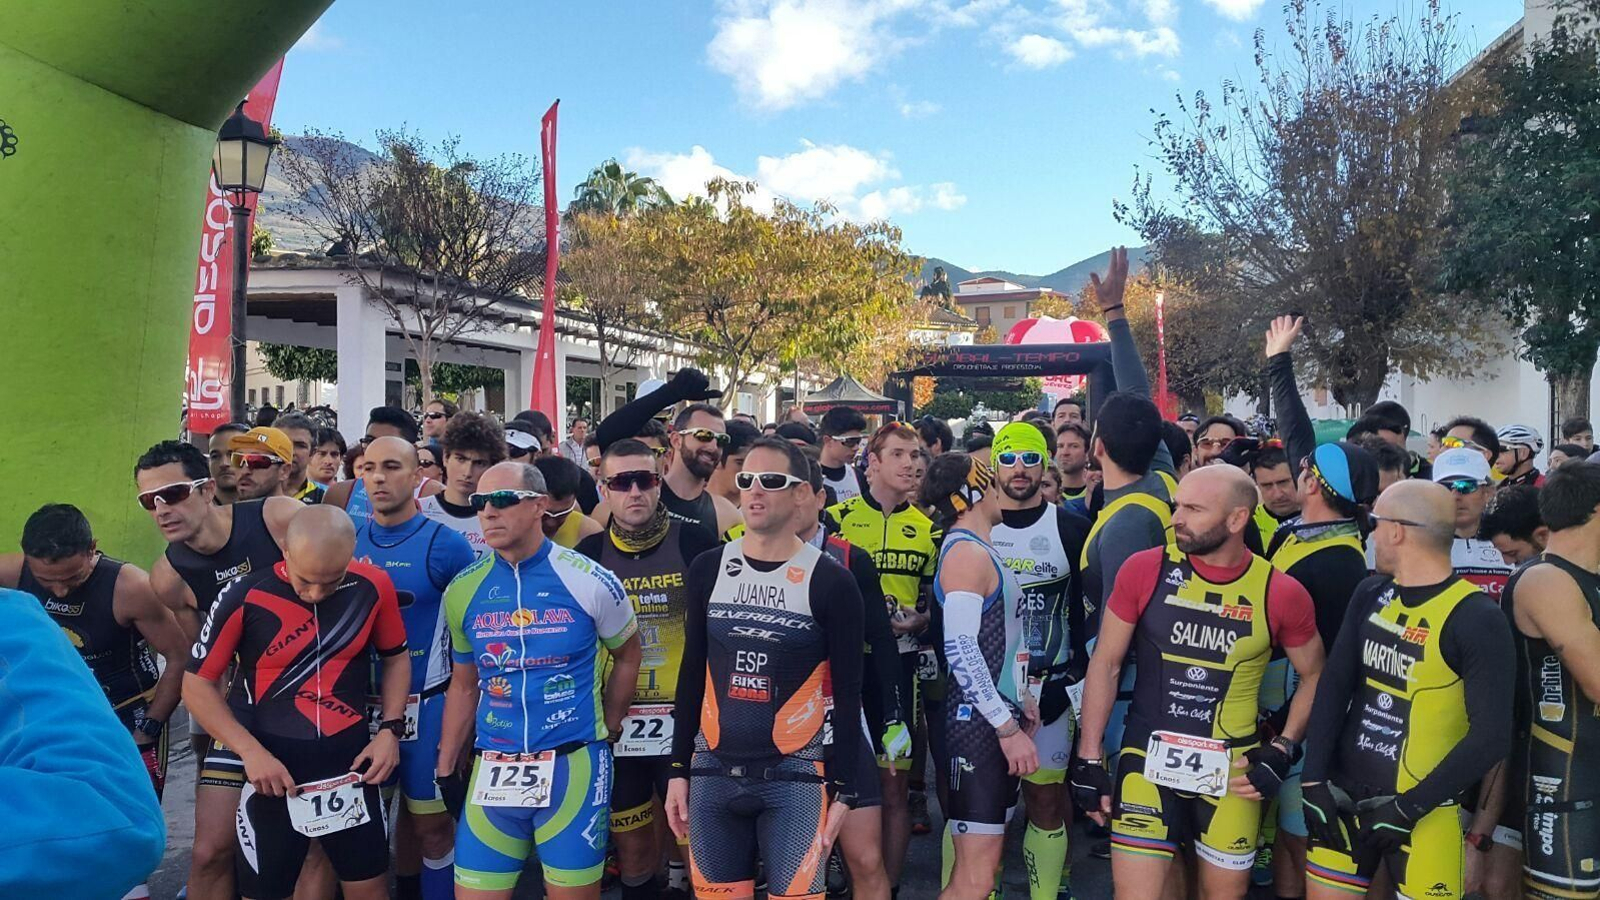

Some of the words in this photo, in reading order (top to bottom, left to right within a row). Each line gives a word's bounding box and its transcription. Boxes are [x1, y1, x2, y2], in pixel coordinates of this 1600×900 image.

[733, 583, 786, 609] JUANRA
[200, 577, 242, 644] GIANT
[707, 608, 814, 631] SILVERBACK
[265, 615, 316, 657] GIANT
[1170, 621, 1238, 655] SALINAS
[735, 650, 768, 673] ESP
[1363, 638, 1419, 682] MARTÍNEZ
[731, 675, 768, 690] BIKE
[1169, 678, 1220, 692] Surponiente
[298, 690, 358, 719] GIANT
[629, 718, 664, 739] 22
[1165, 747, 1203, 773] 54
[489, 765, 540, 788] 125
[310, 791, 345, 818] 16
